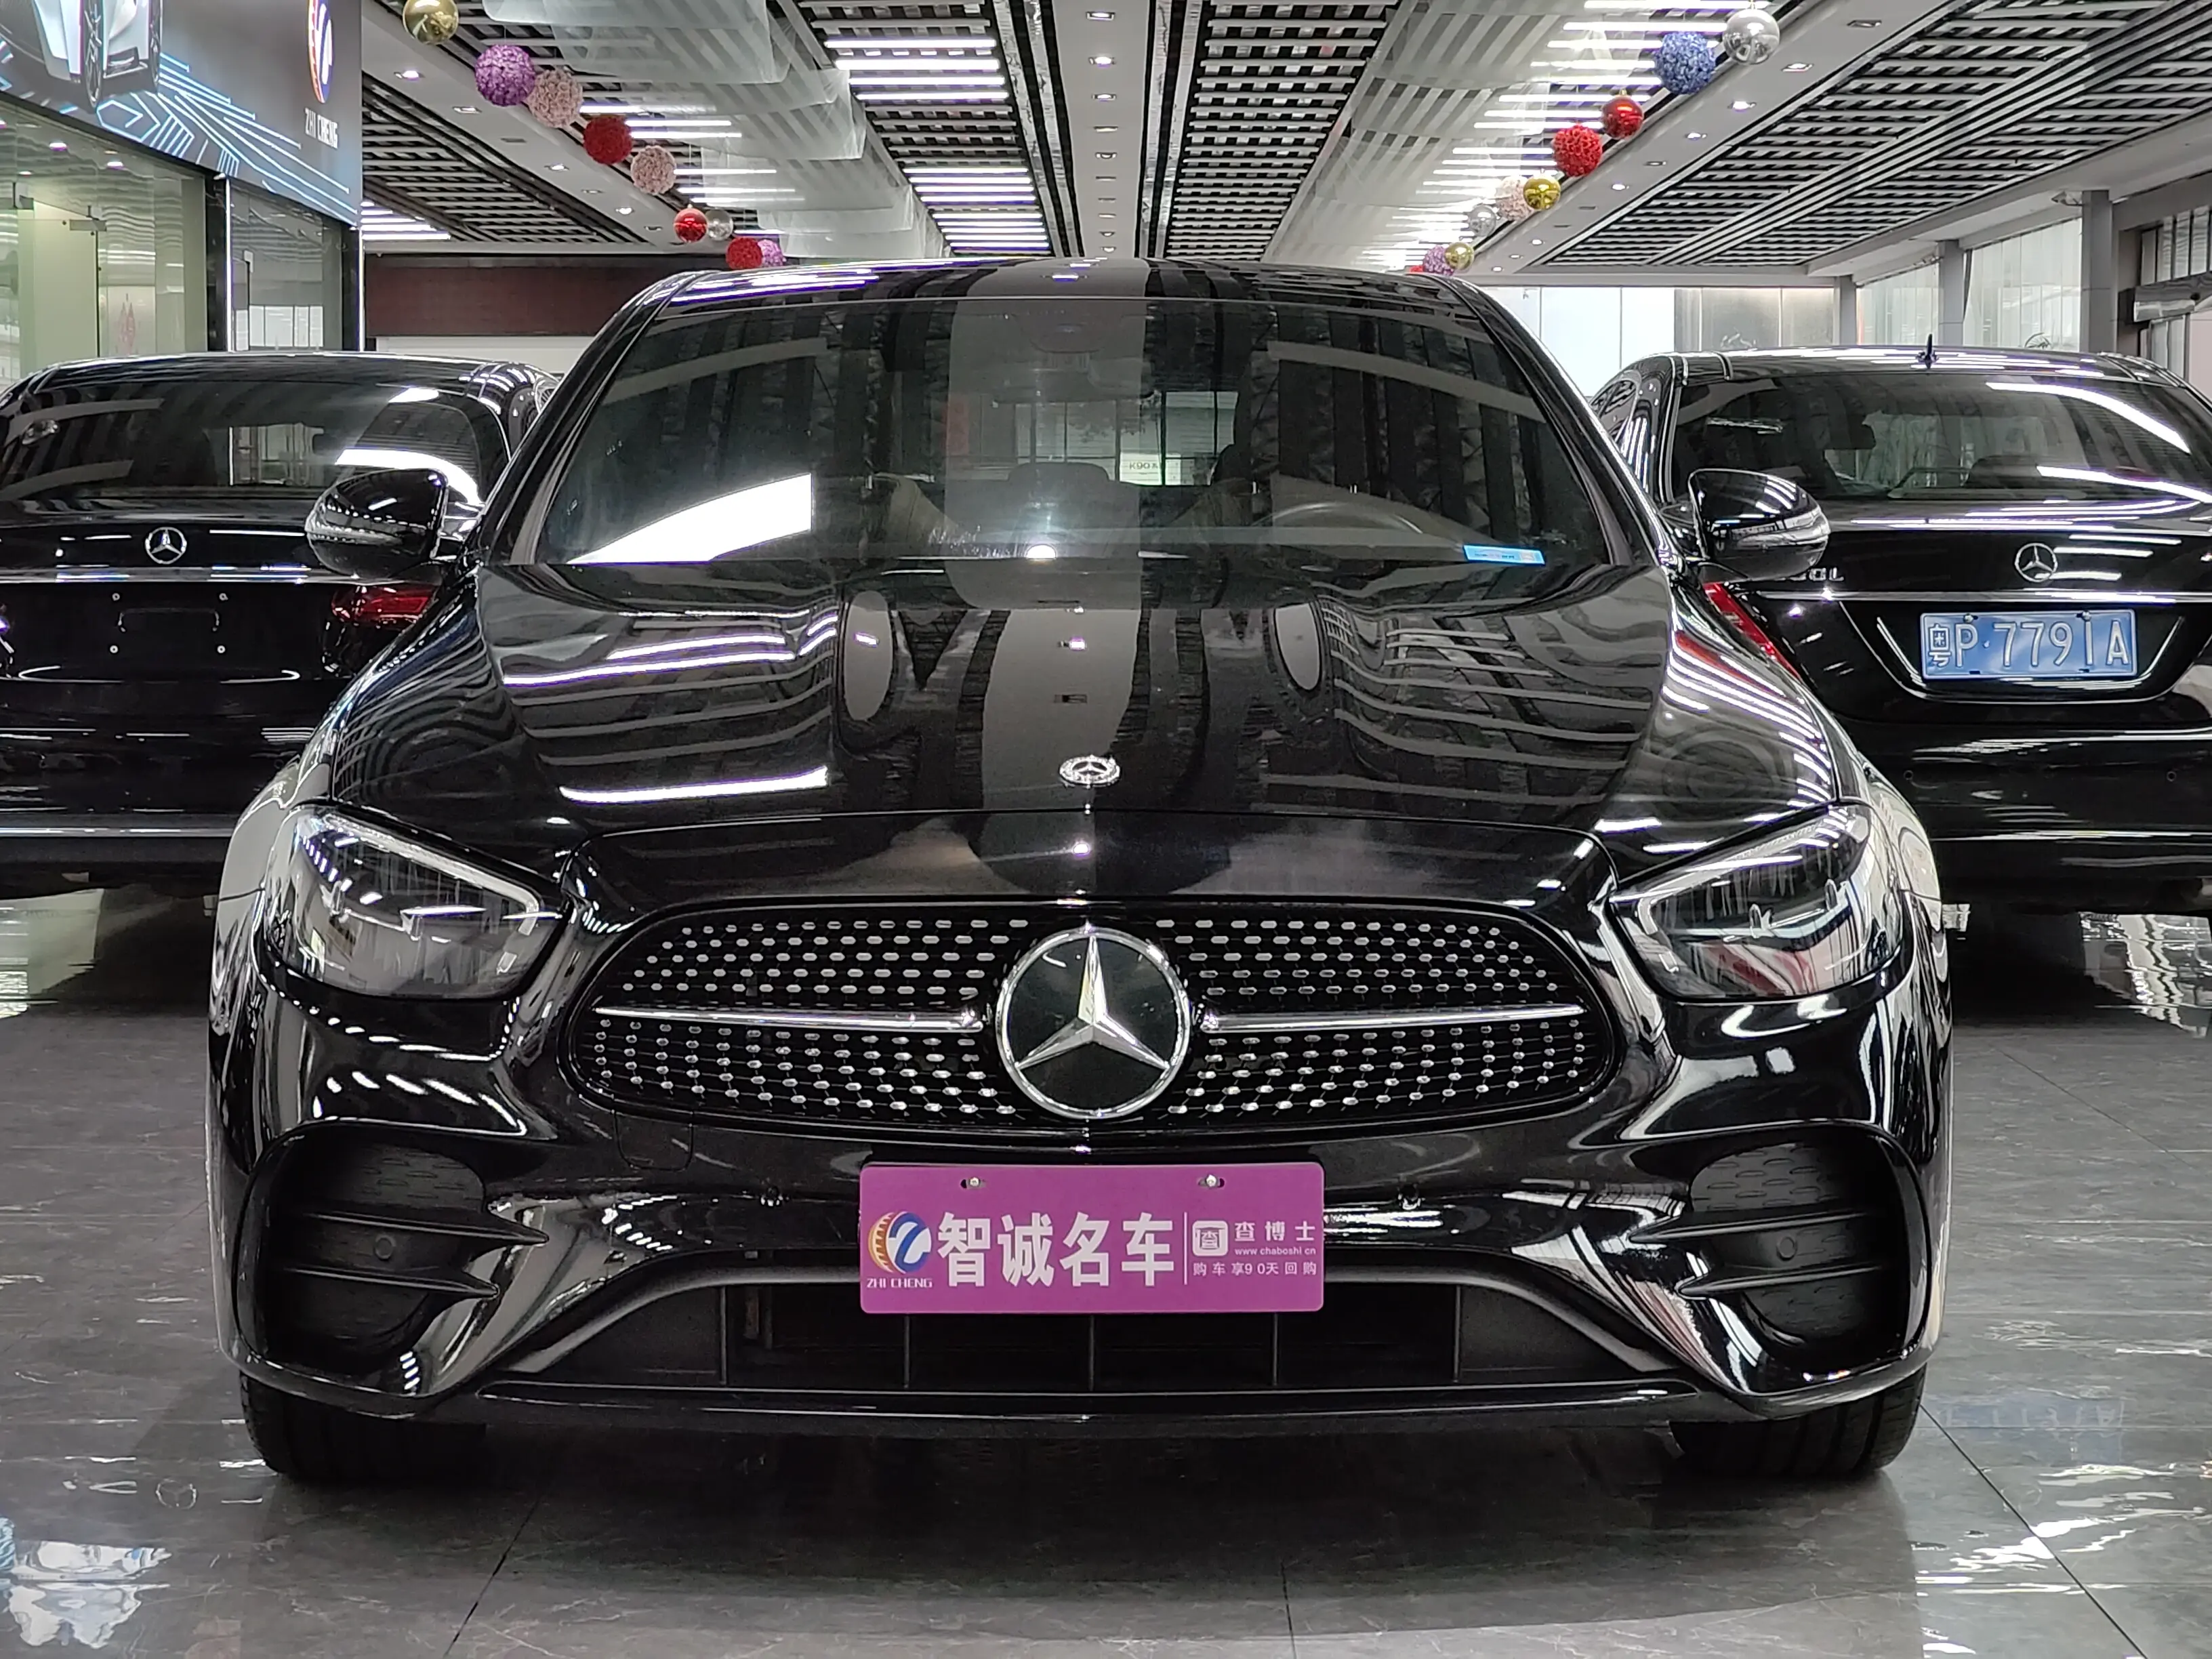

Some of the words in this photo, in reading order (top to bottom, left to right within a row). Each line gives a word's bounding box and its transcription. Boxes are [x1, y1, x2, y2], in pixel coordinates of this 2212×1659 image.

[304, 107, 316, 139] ZHI
[316, 114, 338, 149] CHENG
[1234, 1221, 1316, 1242] 查博士
[937, 1211, 1174, 1287] 智诚名车
[867, 1277, 887, 1288] ZHI
[890, 1277, 933, 1288] CHENG
